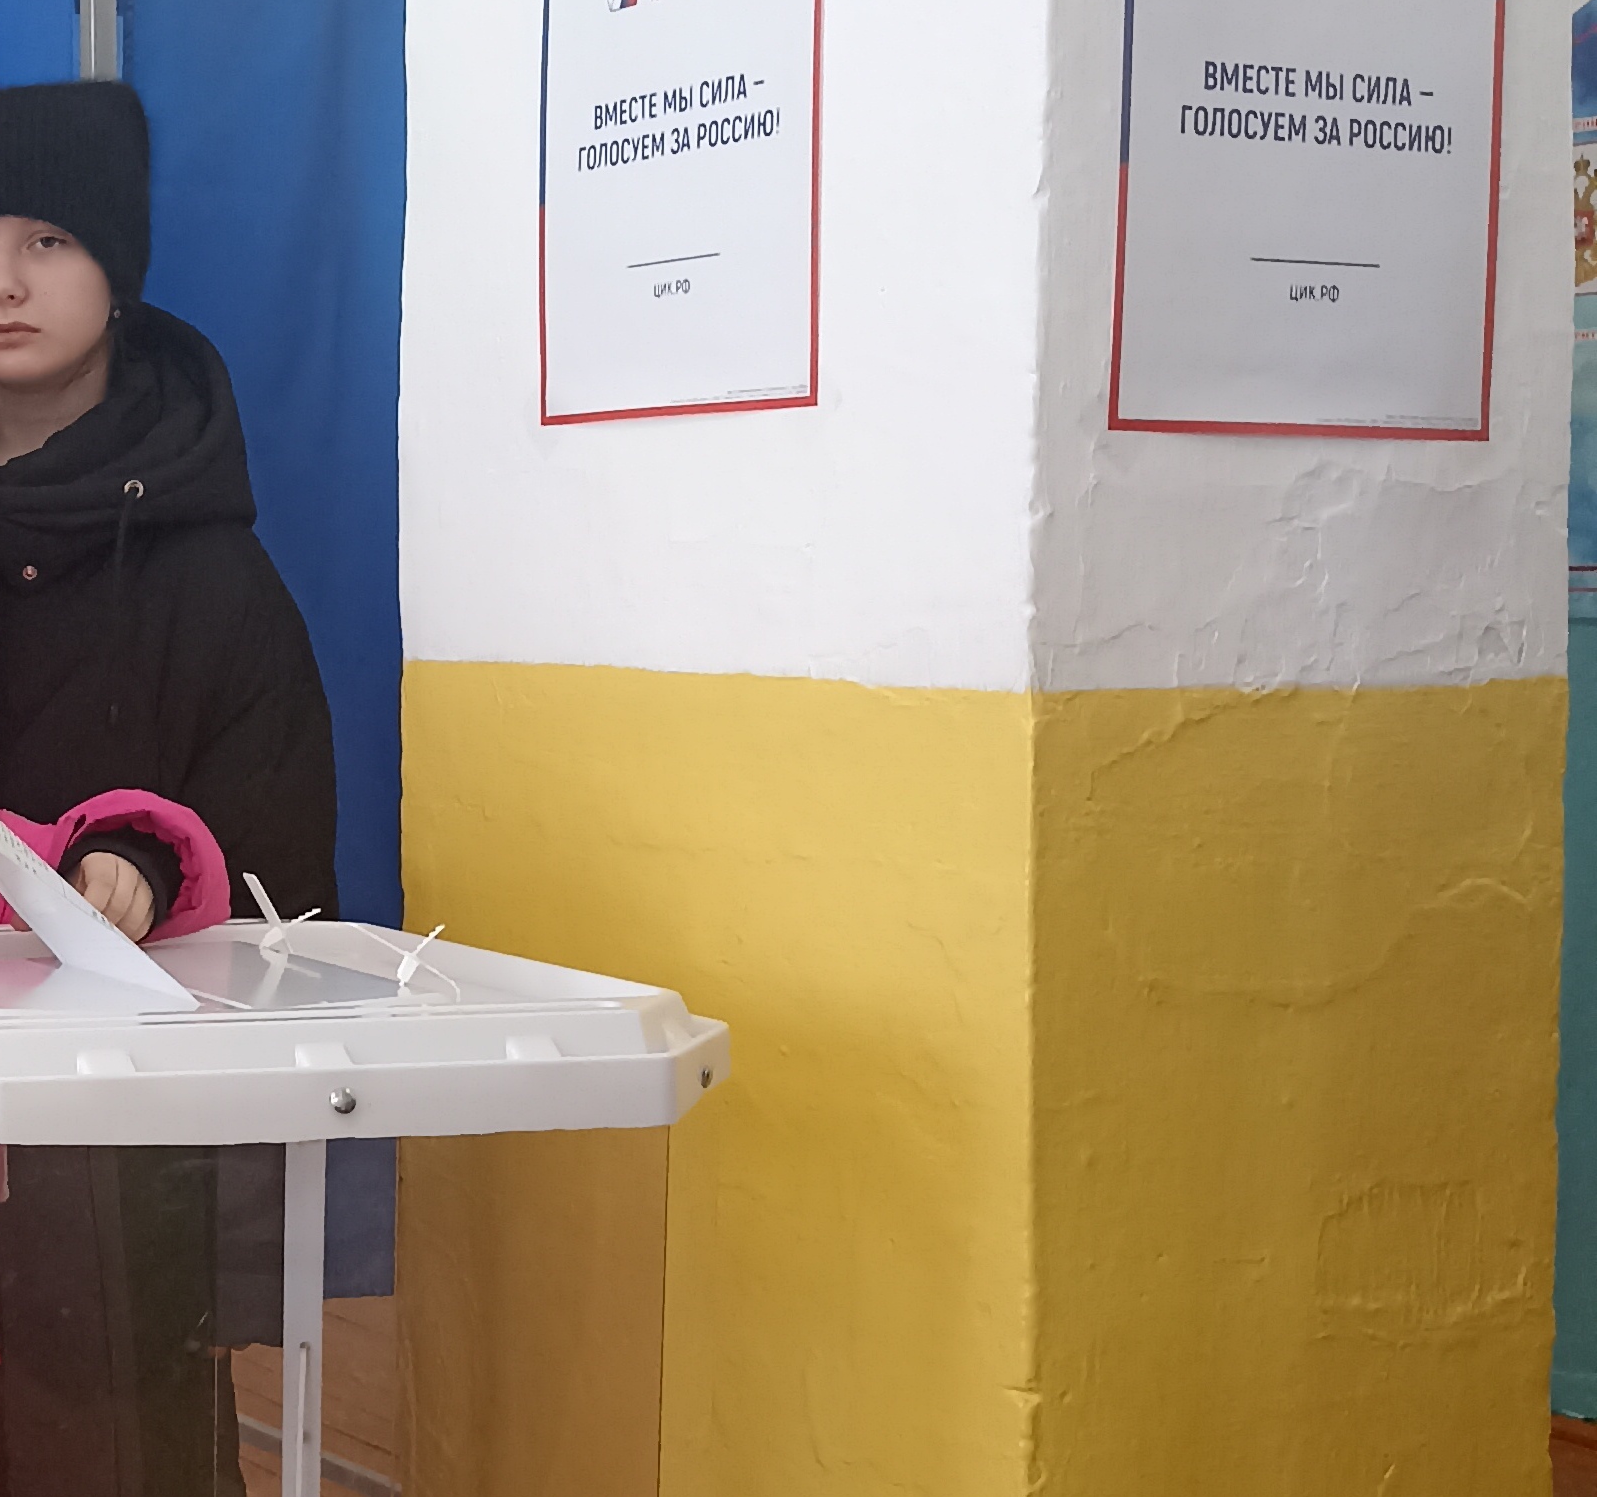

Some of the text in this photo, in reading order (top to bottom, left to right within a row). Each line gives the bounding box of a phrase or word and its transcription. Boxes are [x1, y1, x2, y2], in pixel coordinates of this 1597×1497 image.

[594, 92, 658, 131] ВМЕСТЕ
[663, 85, 693, 113] МЫ
[699, 73, 747, 108] СИЛА
[1203, 60, 1297, 98] ВМЕСТЕ
[1304, 69, 1344, 101] МЫ
[1352, 73, 1412, 106] СИЛА
[577, 107, 781, 172] ГОЛОСУЕМ ЗА РОССИЮ!
[1180, 104, 1453, 155] ГОЛОСУЕМ ЗА РОССИЮ!
